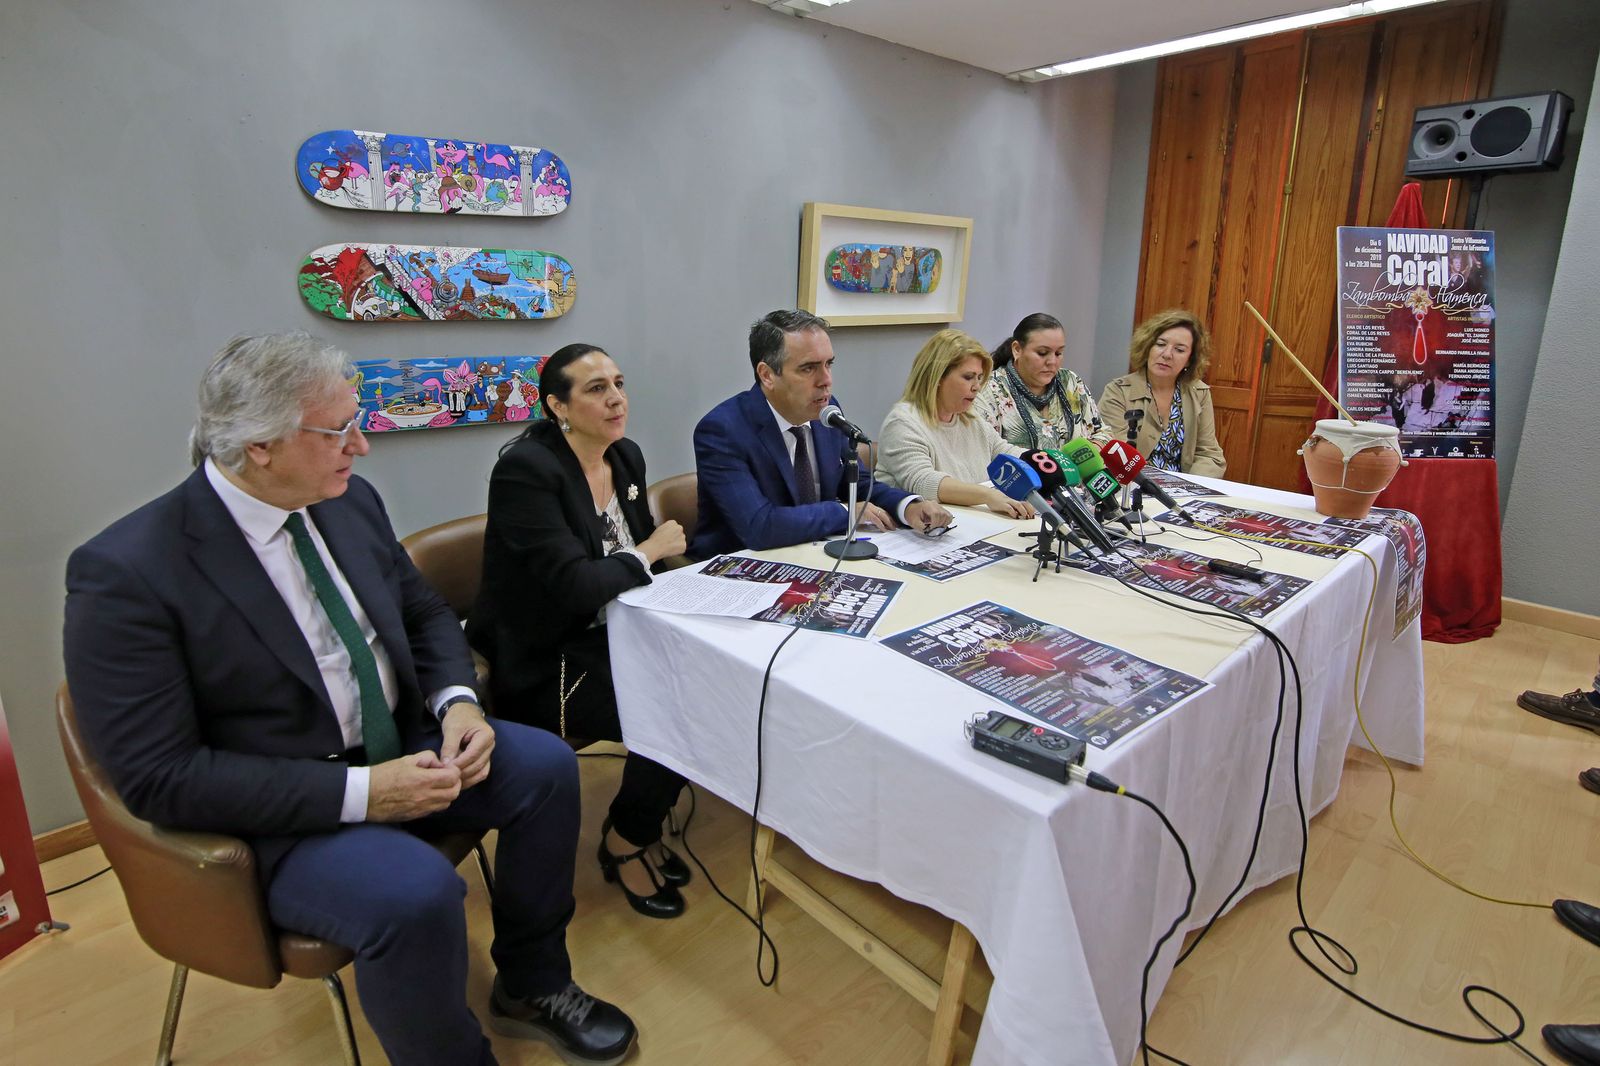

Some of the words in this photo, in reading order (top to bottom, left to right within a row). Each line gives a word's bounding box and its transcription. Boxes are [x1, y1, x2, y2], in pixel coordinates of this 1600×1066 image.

[1387, 233, 1448, 254] NAVIDAD
[1387, 254, 1449, 288] Coral
[1342, 272, 1411, 308] Zambomba
[1107, 442, 1128, 465] 7
[1124, 454, 1140, 472] Siete
[920, 614, 974, 636] NAVIDAD
[938, 620, 1003, 648] Coral
